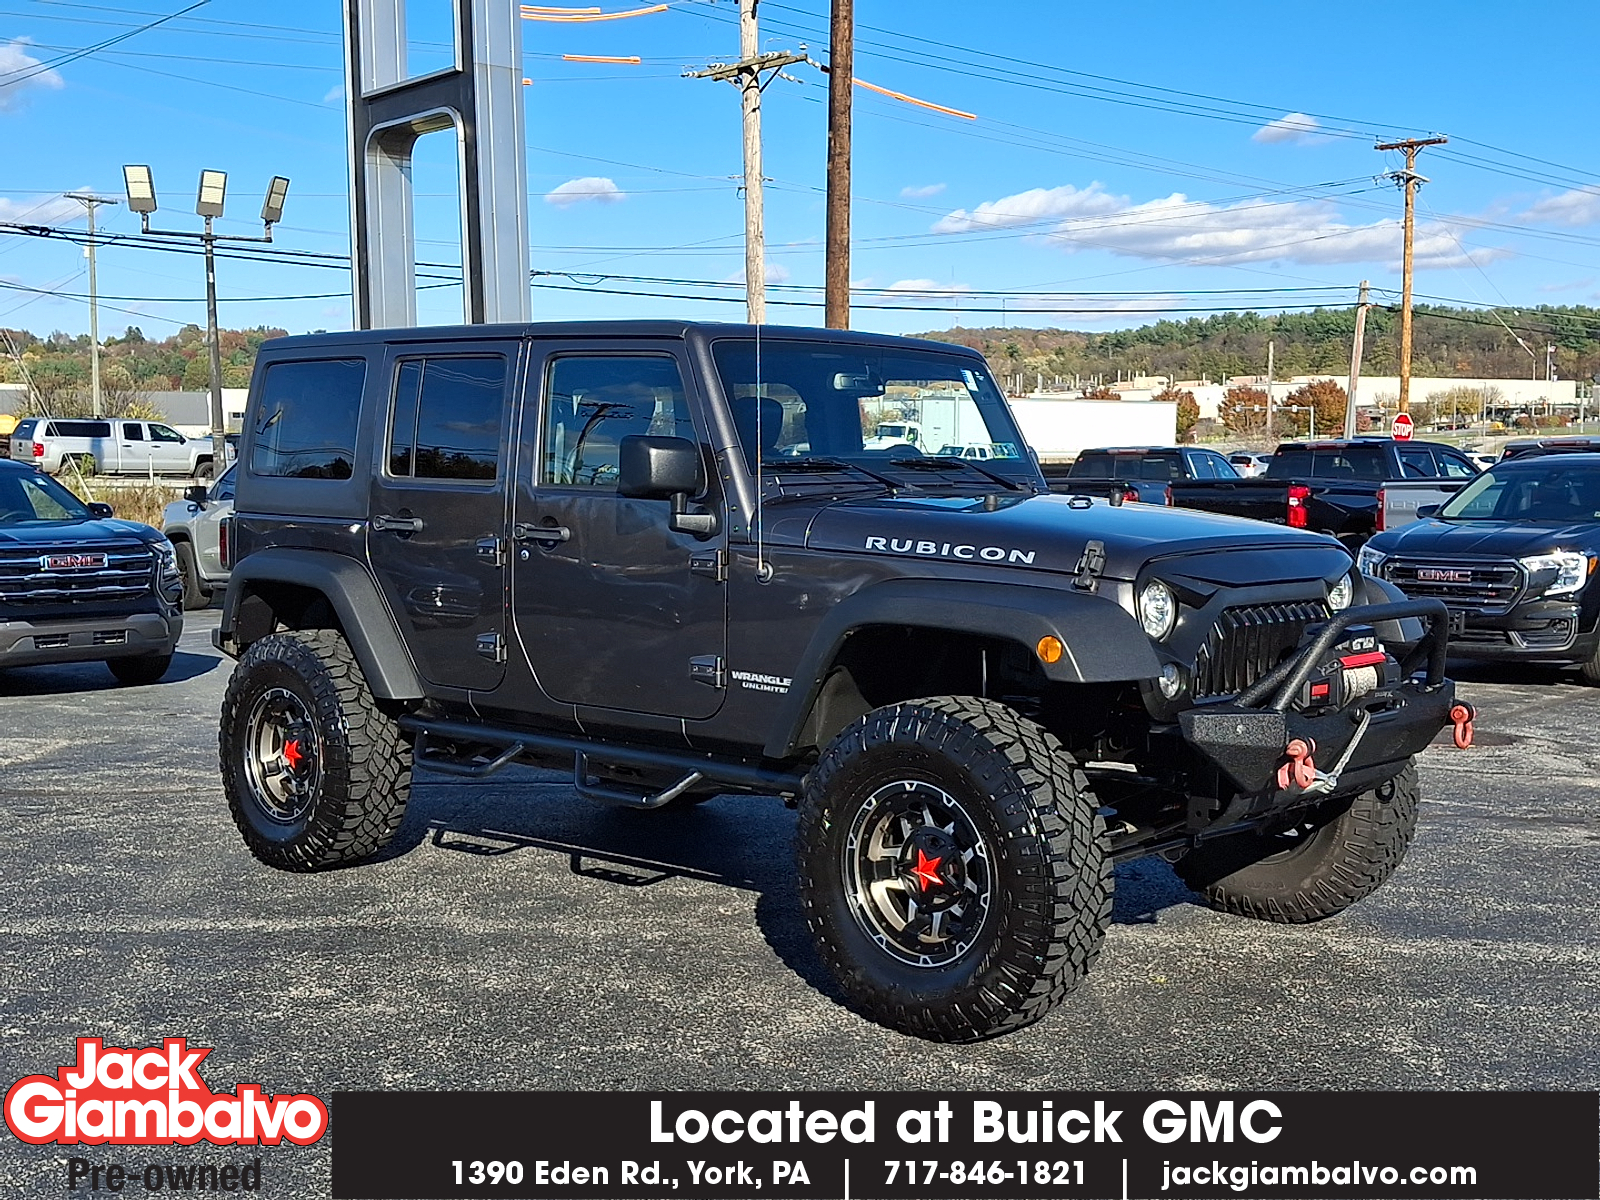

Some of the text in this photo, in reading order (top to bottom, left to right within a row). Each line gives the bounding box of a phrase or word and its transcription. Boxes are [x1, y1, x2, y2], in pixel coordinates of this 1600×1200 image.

[1393, 423, 1412, 437] STOP
[865, 536, 1036, 564] RUBICON
[47, 555, 105, 568] GMC
[1417, 569, 1472, 582] GMC
[731, 670, 793, 687] WRANGLE
[742, 681, 789, 694] UNLIMITE
